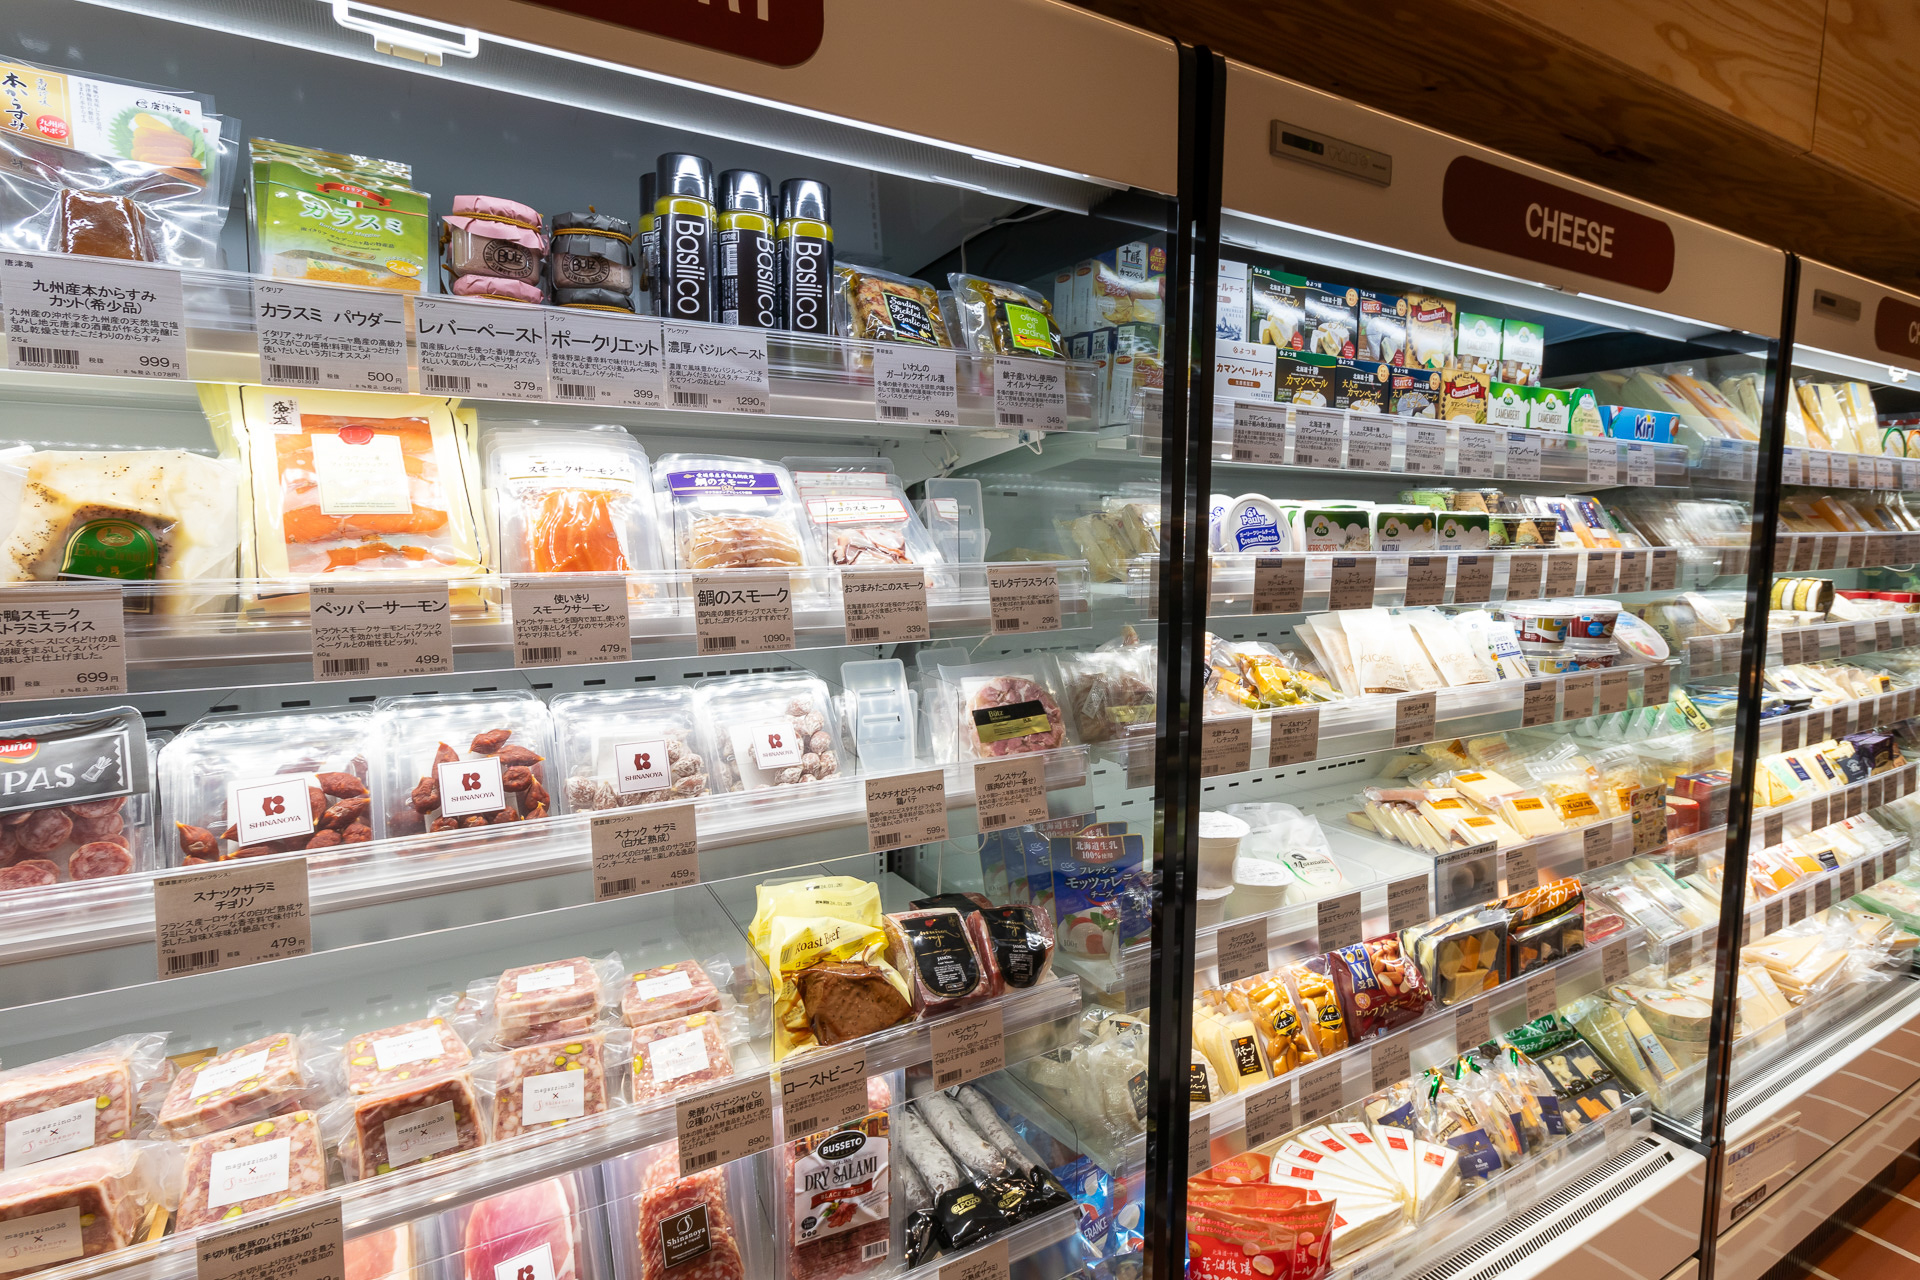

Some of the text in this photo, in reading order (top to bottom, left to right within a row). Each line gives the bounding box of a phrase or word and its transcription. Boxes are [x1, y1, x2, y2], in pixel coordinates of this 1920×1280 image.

[2, 72, 28, 132] 本からすみ
[39, 118, 68, 132] 九州産
[300, 203, 404, 236] カラスミ
[1525, 202, 1615, 259] CHEESE
[1122, 246, 1143, 264] 十勝
[5, 259, 33, 268] 唐津海
[676, 220, 704, 314] Basilico
[259, 286, 284, 294] イタリア
[756, 237, 776, 329] Basilico
[795, 242, 822, 331] Basilico
[33, 279, 157, 303] 九州産本からすみ
[890, 296, 921, 312] Sardine
[261, 303, 402, 328] カラスミ パウダー
[890, 304, 922, 320] Pickled
[1020, 313, 1039, 325] olive
[1417, 308, 1446, 323] Camembert
[893, 313, 932, 332] Garlic oil
[1026, 321, 1036, 331] oil
[418, 317, 543, 345] レバーペースト
[1018, 328, 1046, 340] sardine
[11, 336, 28, 344] 25g
[551, 330, 660, 357] ポークリエット
[668, 341, 765, 360] 濃厚バジルペースト
[902, 363, 930, 373] いわしの
[1285, 375, 1328, 388] カマンベール
[1342, 379, 1359, 389] 大人の
[1394, 378, 1412, 387] 切れてる
[1296, 387, 1320, 399] チーズ
[1347, 388, 1382, 398] カマンベール
[1451, 385, 1480, 399] Camembert
[1495, 410, 1520, 421] CAMEMBERT
[1538, 412, 1562, 425] CAMEMBERT
[1635, 414, 1655, 440] Kiri
[528, 464, 616, 476] スモークサーモン
[695, 477, 757, 488] 鯛のスモーク
[1241, 513, 1265, 525] Pauly
[1240, 533, 1277, 545] Cream Cheese
[844, 582, 924, 594] おつまみたこのスモーク
[990, 577, 1057, 588] モルタデラスライス
[554, 593, 590, 604] 使いきり
[697, 587, 789, 607] 鯛のスモーク
[0, 608, 80, 622] 鴨スモーク
[315, 600, 447, 616] ペッパーサーモン
[533, 604, 610, 615] スモークサーモン
[0, 621, 96, 635] トラミスライス
[762, 749, 793, 758] SHINANOYA
[625, 771, 663, 781] SHINANOYA
[451, 791, 495, 803] SHINANOYA
[249, 815, 302, 830] SHINANOYA
[614, 822, 677, 839] スナック サラミ
[1076, 841, 1118, 851] 北海道生乳
[1080, 866, 1117, 875] フレッシュ
[193, 881, 275, 903] スナックサラミ
[1091, 891, 1113, 899] チーズ
[215, 897, 254, 911] チョリソ
[794, 926, 841, 955] Roast Beef
[1350, 964, 1370, 980] W
[1357, 980, 1375, 989] 受賞
[1279, 1016, 1294, 1028] スモーク
[1325, 1012, 1341, 1022] スモーク
[948, 1020, 988, 1039] ハモンセラーノ
[957, 1031, 979, 1043] ブロック
[1235, 1042, 1255, 1057] スモーク
[784, 1060, 865, 1095] ローストビーフ
[22, 1114, 82, 1136] magazzino38
[397, 1115, 444, 1134] magazzino38
[822, 1137, 862, 1155] BUSSETO
[225, 1153, 278, 1170] magazzino38
[805, 1156, 878, 1191] DRY SALAMI
[820, 1191, 841, 1201] BLACK
[5, 1223, 66, 1240] magazzino38
[1084, 1217, 1109, 1242] FRANCE
[666, 1227, 706, 1247] Shinanoya
